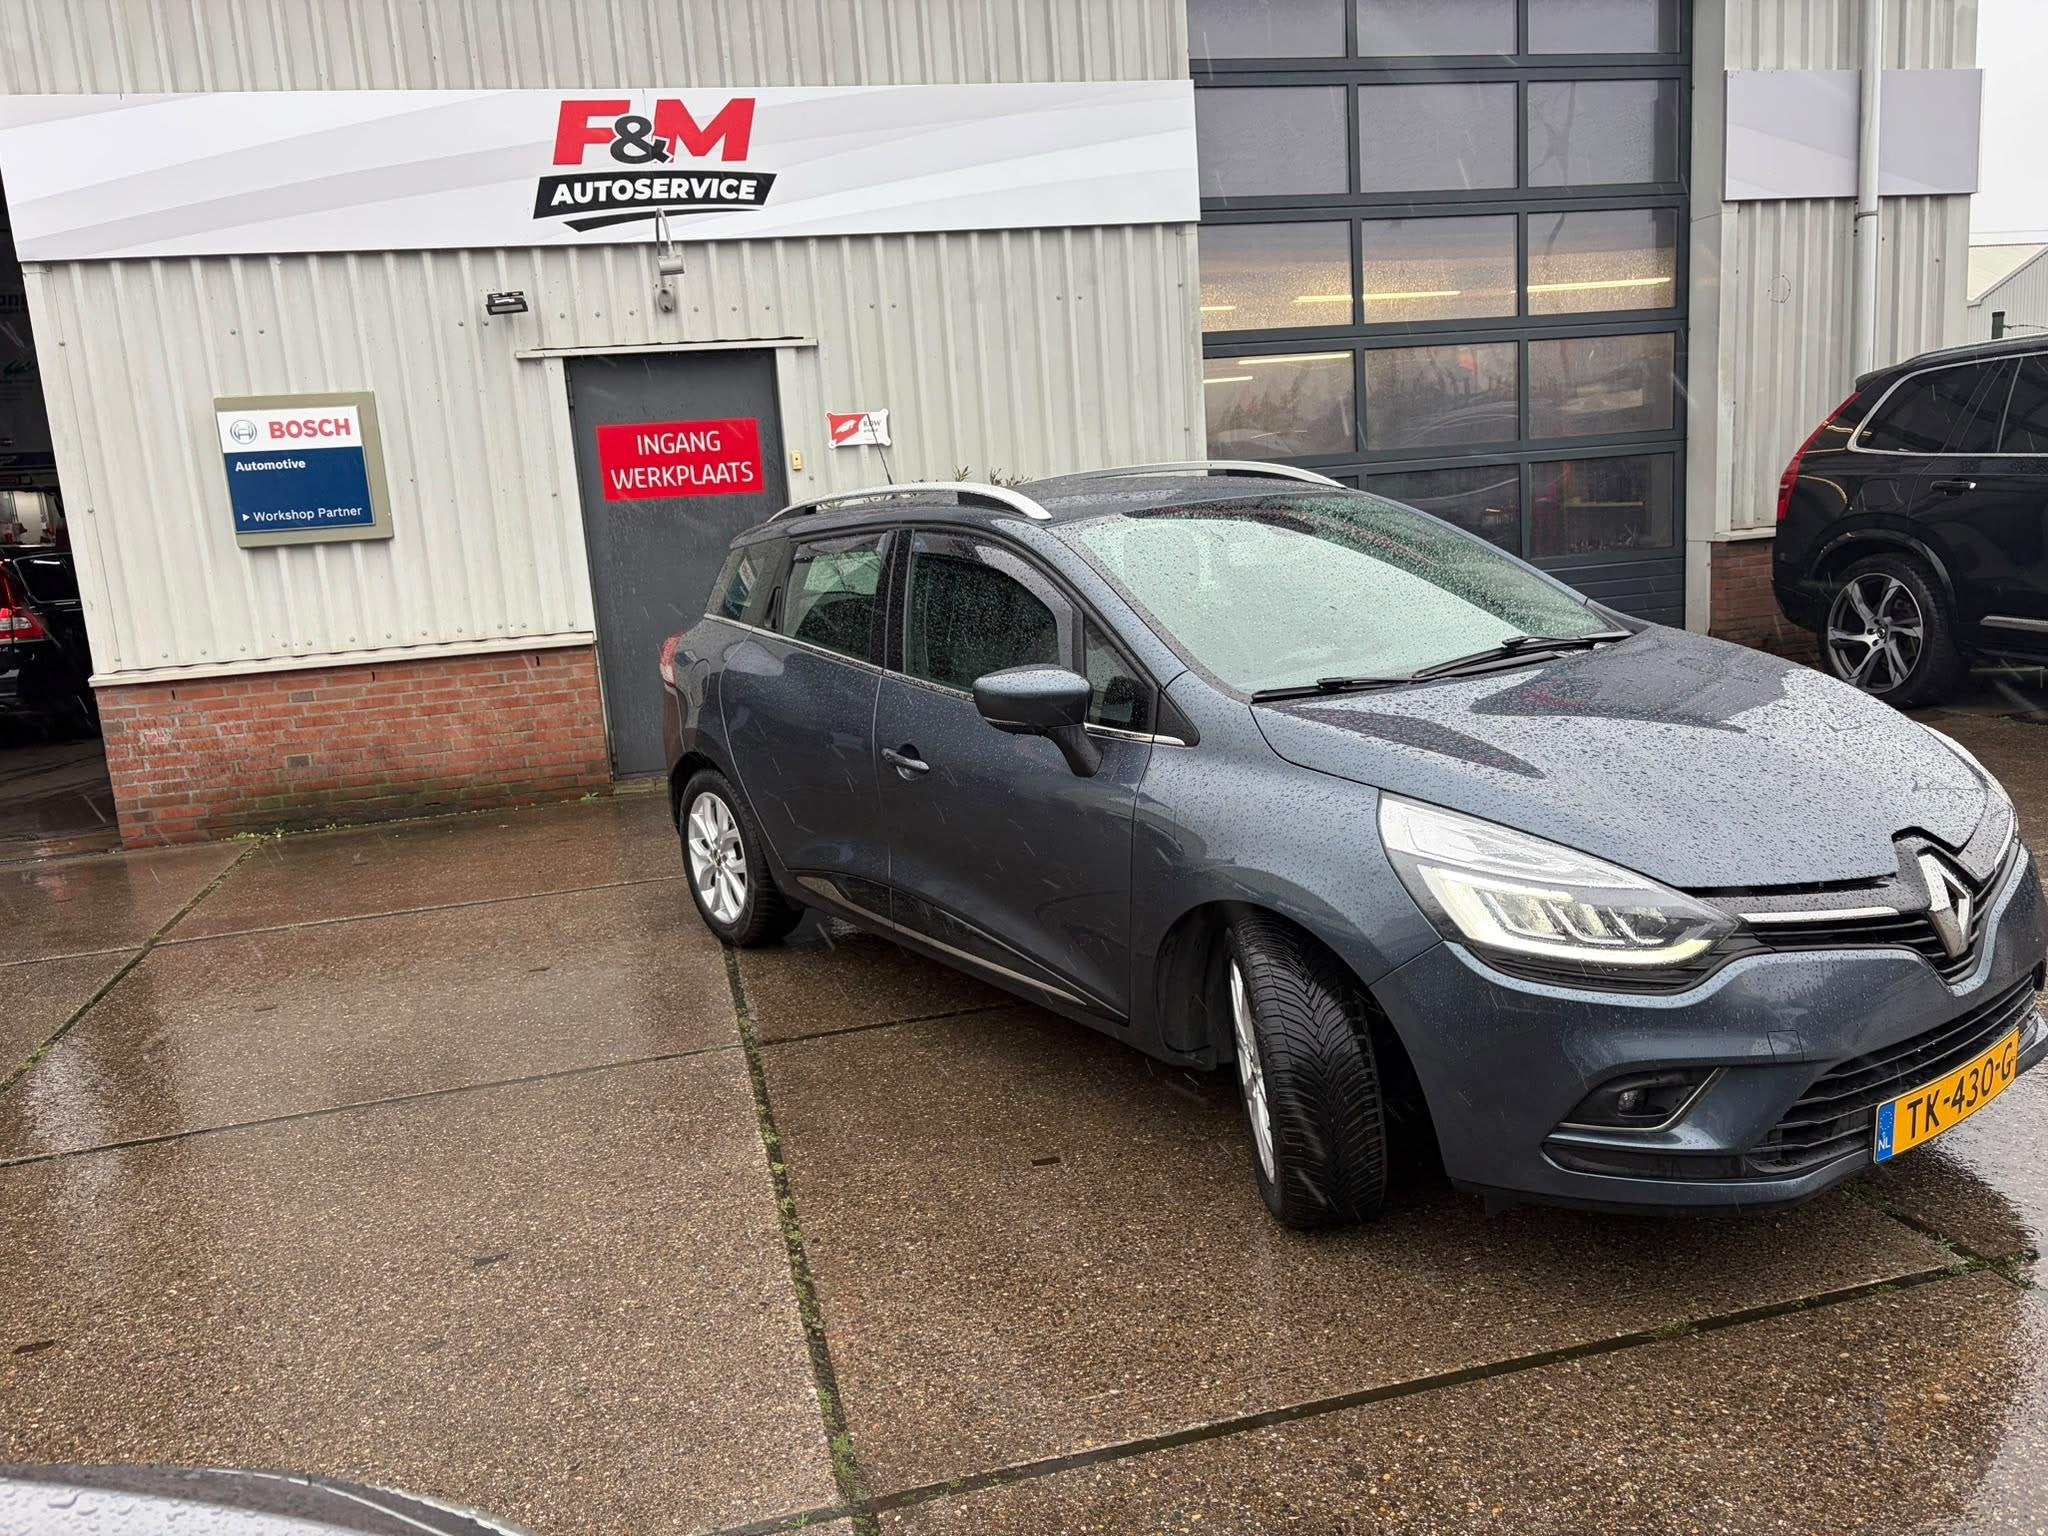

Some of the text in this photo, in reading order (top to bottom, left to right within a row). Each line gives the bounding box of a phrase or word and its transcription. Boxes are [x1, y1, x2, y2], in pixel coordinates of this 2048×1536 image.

[553, 98, 756, 165] F&M
[551, 178, 757, 206] AUTOSERVICE
[268, 418, 352, 439] BOSCH
[636, 430, 721, 456] INGANG
[235, 458, 307, 472] Automotive
[610, 461, 755, 490] WERKPLAATS
[253, 506, 363, 522] Workshop Partner
[1907, 1042, 2014, 1140] TK-430-G
[1877, 1136, 1892, 1152] NL
